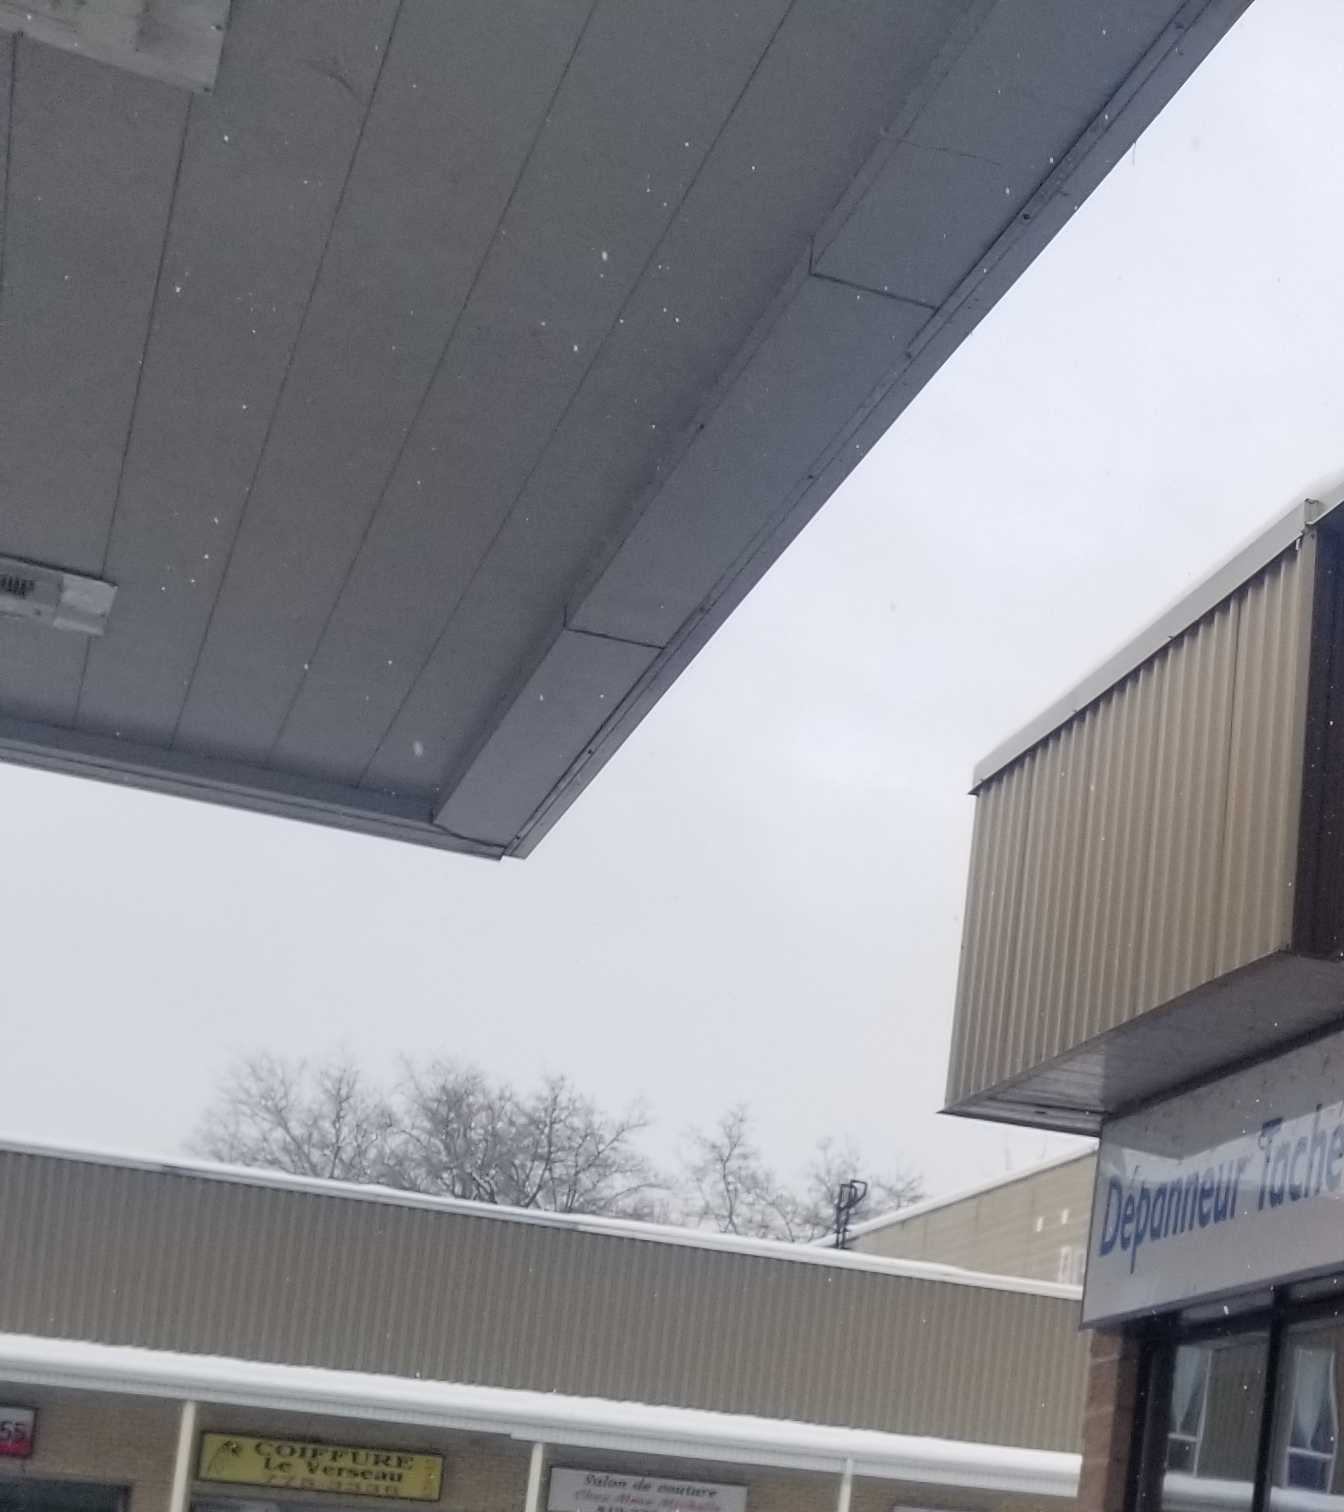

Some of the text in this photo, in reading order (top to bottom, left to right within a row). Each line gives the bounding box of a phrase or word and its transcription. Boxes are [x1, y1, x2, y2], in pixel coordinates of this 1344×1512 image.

[1099, 1157, 1250, 1275] Dépanneur
[254, 1440, 415, 1471] COIFFURE
[263, 1456, 292, 1474] Le
[306, 1460, 404, 1483] Verseau
